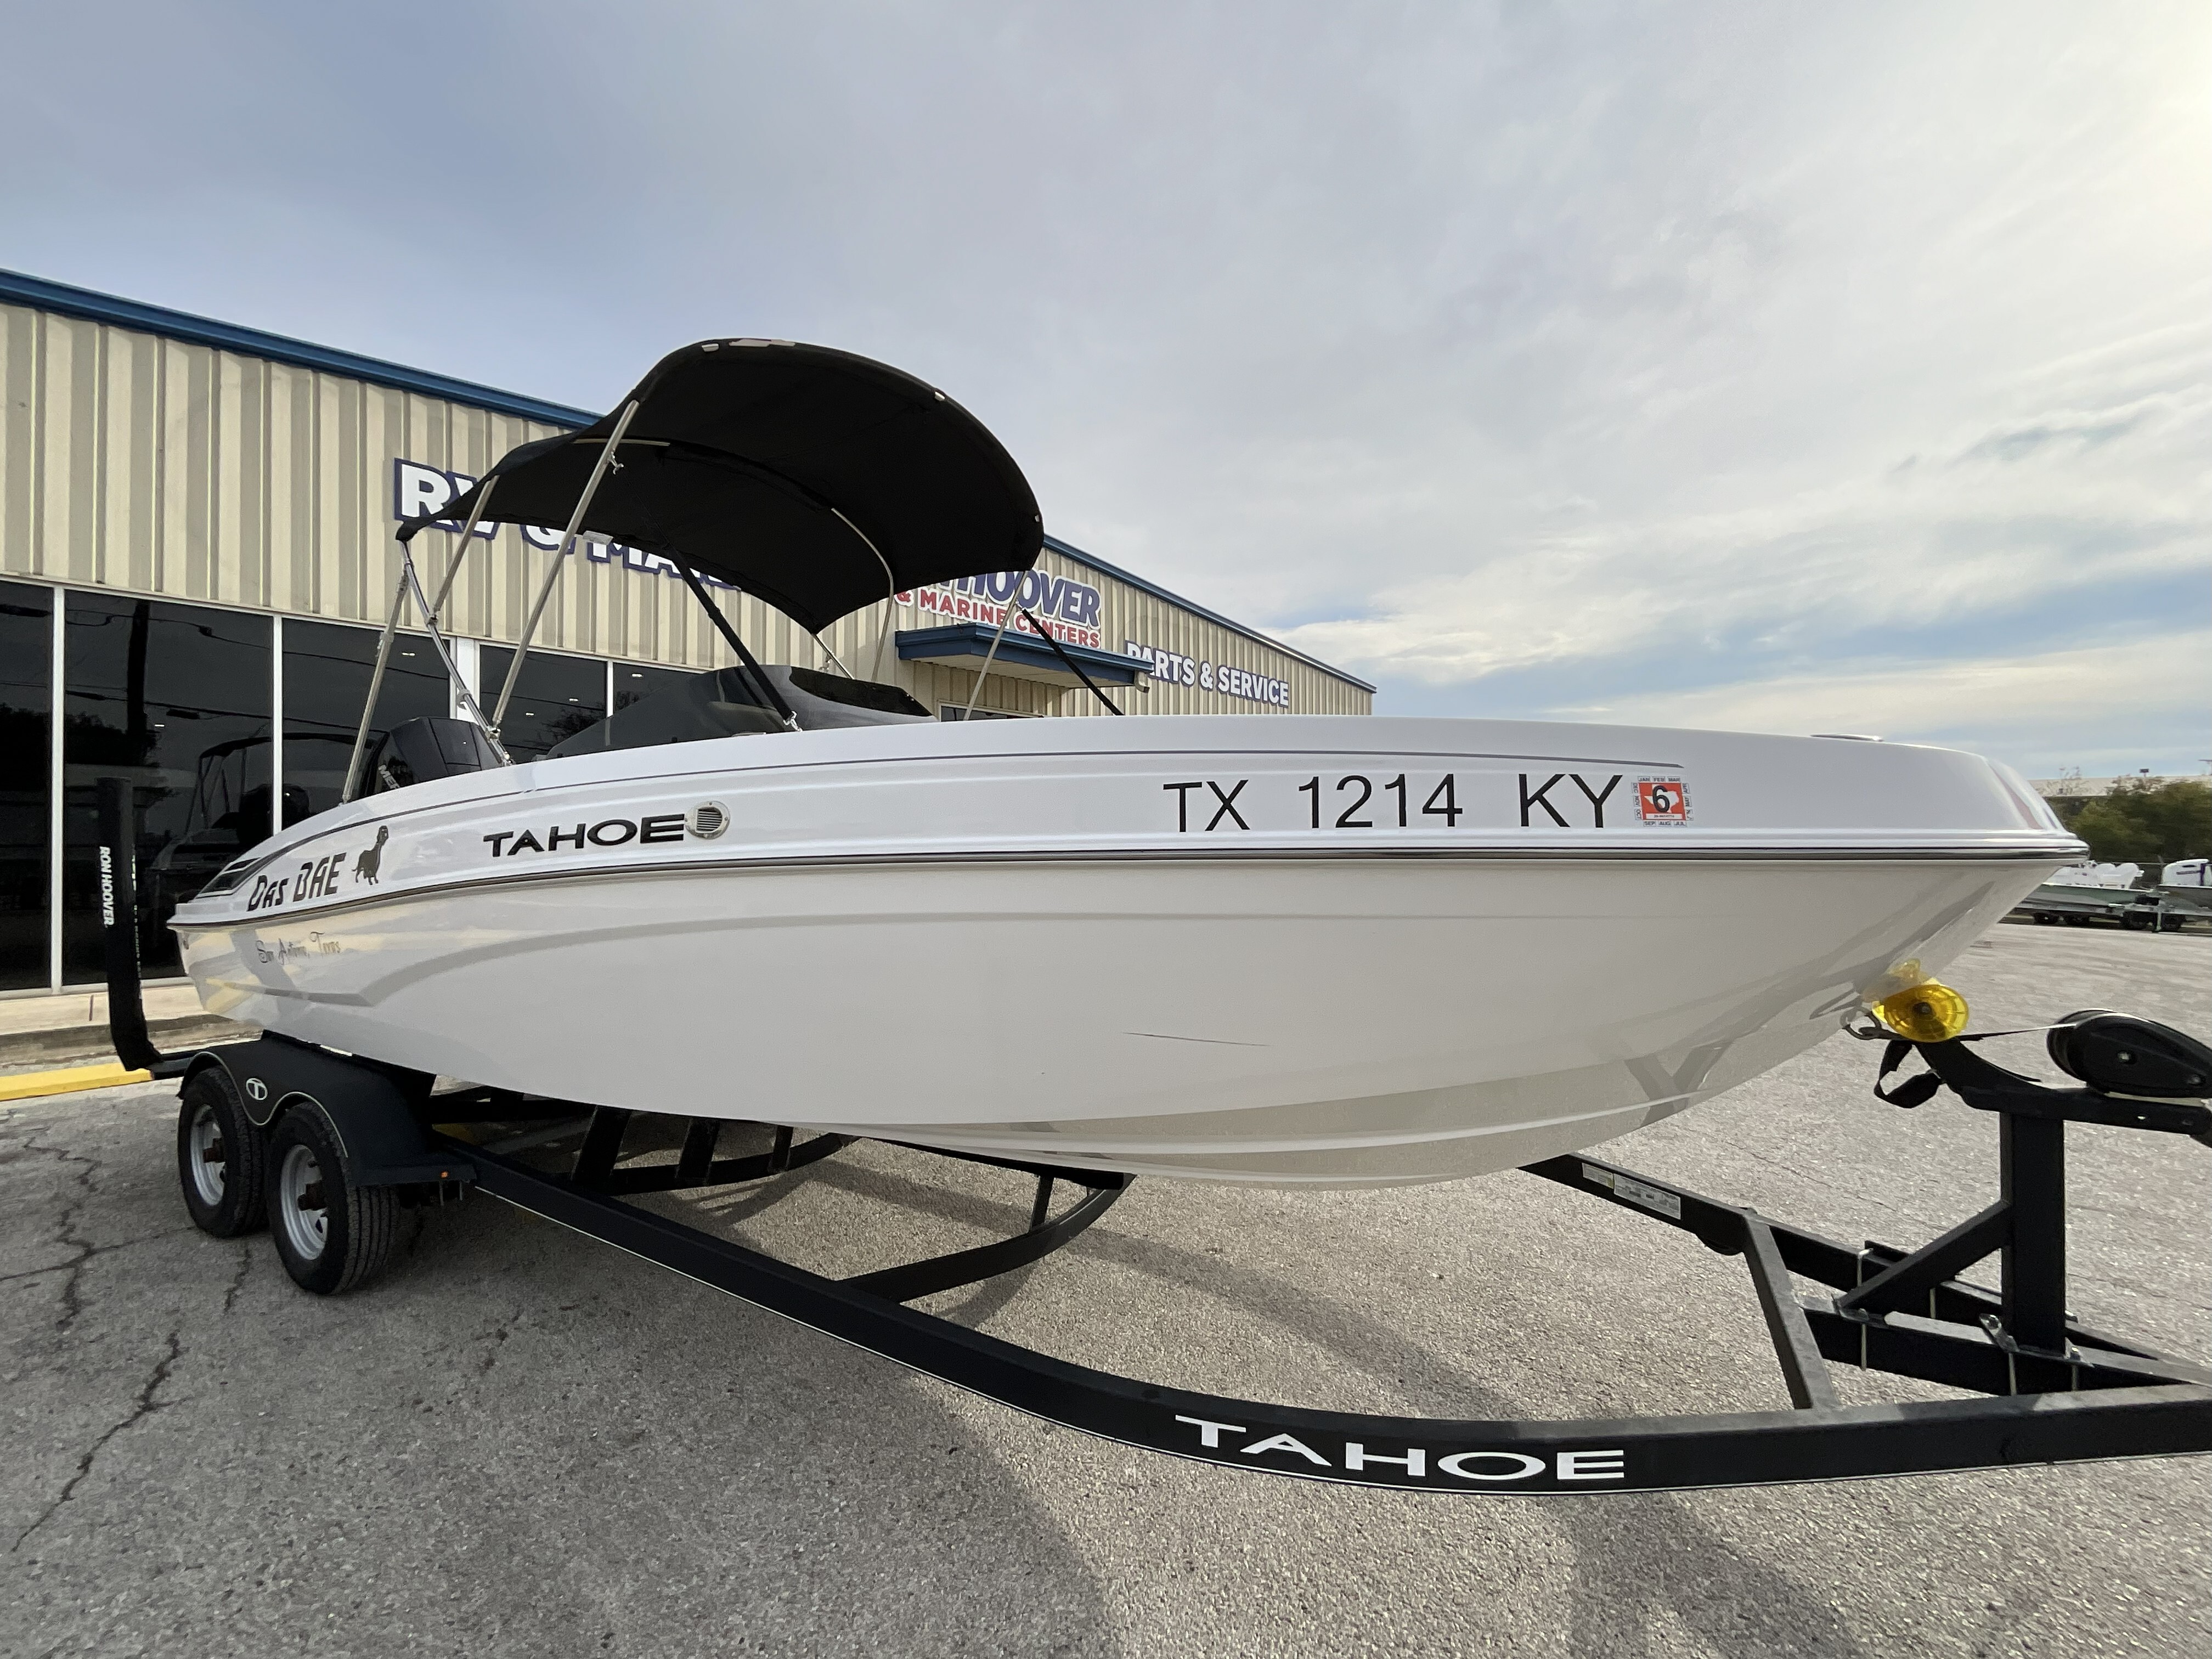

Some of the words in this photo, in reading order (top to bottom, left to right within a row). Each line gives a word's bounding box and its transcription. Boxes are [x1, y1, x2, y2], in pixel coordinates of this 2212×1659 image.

[920, 588, 1008, 626] MARINE
[1015, 614, 1099, 648] CENTERS
[1200, 662, 1213, 690] &
[1217, 666, 1289, 706] SERVICE
[1163, 780, 1251, 832] TX
[1299, 774, 1463, 829] 1214
[1519, 774, 1623, 828] KY
[1652, 785, 1670, 813] 6
[483, 813, 685, 857] TAHOE
[99, 846, 112, 873] RON
[101, 873, 115, 926] HOOVER
[1175, 1414, 1624, 1480] TAHOE
